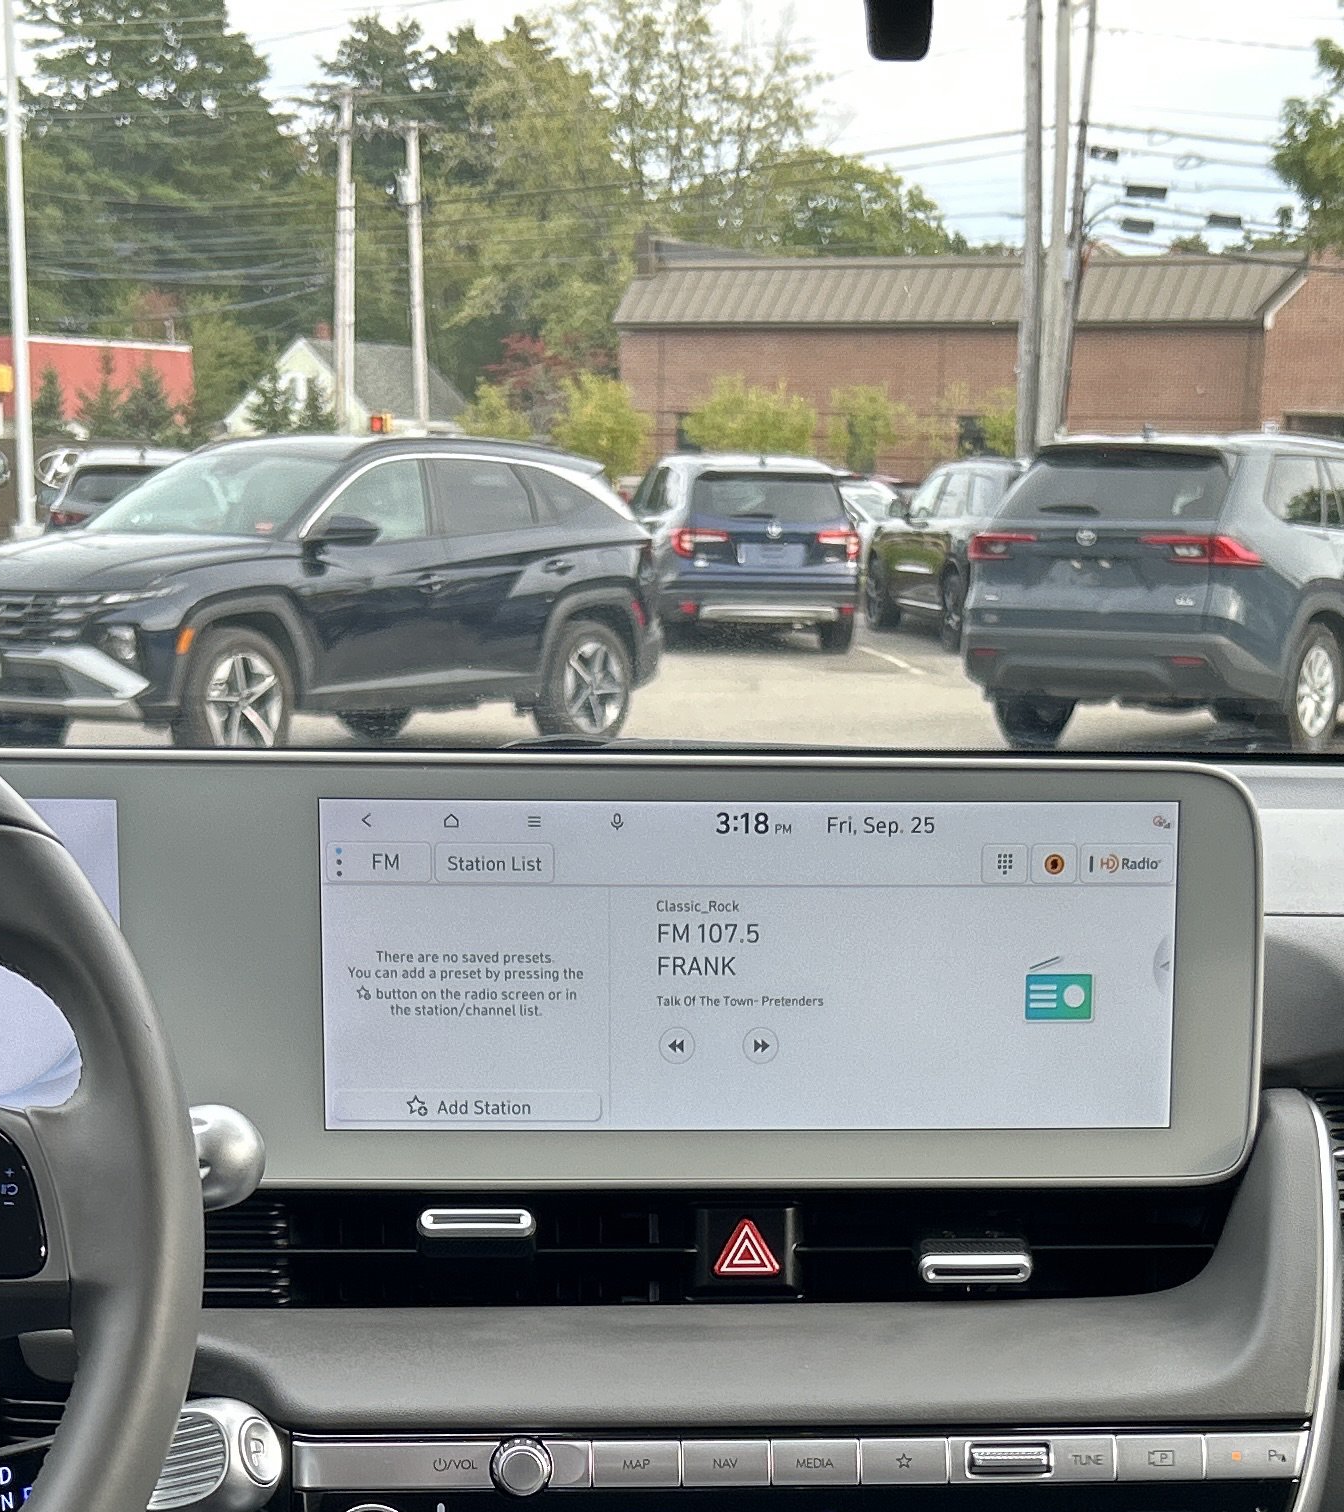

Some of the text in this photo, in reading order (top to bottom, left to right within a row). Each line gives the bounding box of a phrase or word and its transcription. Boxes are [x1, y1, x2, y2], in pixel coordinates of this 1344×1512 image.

[715, 812, 792, 834] 3:18 PM
[827, 816, 935, 837] Fri, Sep. 25
[372, 853, 400, 870] FM
[447, 856, 542, 872] Station List
[656, 900, 740, 914] Classic_Rock
[657, 923, 760, 943] FM 107.5
[376, 951, 555, 965] There are no saved presets.
[657, 956, 736, 976] FRANK
[348, 967, 584, 982] You can add a preset by pressing the
[376, 988, 577, 1000] button on the radio screen or in
[657, 995, 681, 1007] Talk
[684, 995, 696, 1007] Of
[700, 995, 720, 1007] The
[761, 995, 824, 1007] Pretenders
[390, 1003, 543, 1017] the station/channel list.
[437, 1100, 531, 1115] Add Station
[622, 1459, 650, 1470] MAP
[713, 1458, 738, 1470] NAV
[795, 1457, 834, 1469] MEDIA
[1072, 1454, 1103, 1466] TUNE
[0, 1491, 14, 1512] N
